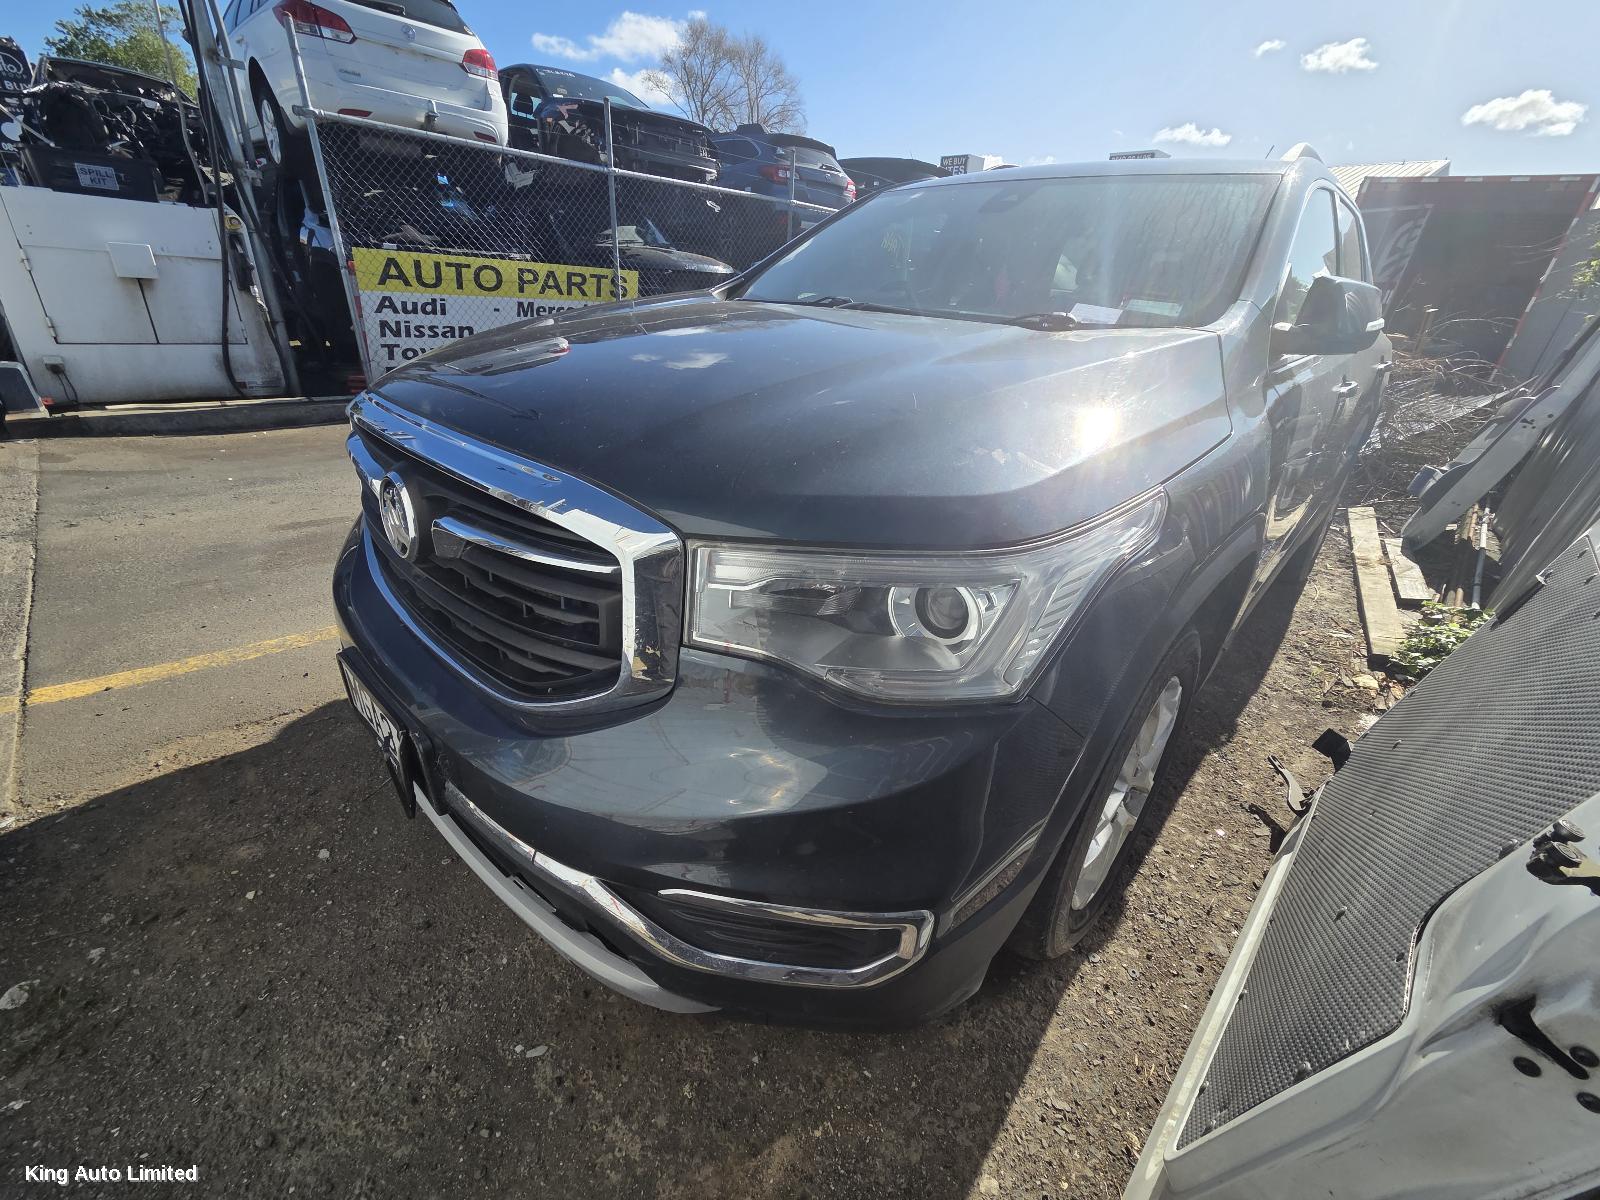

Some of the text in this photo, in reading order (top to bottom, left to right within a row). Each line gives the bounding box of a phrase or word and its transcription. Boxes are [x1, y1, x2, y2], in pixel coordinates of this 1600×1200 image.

[80, 168, 113, 178] SPILL
[90, 177, 106, 185] KIT
[377, 257, 628, 298] AUTO PARTS
[374, 296, 447, 315] Audi
[379, 320, 475, 338] Nissan
